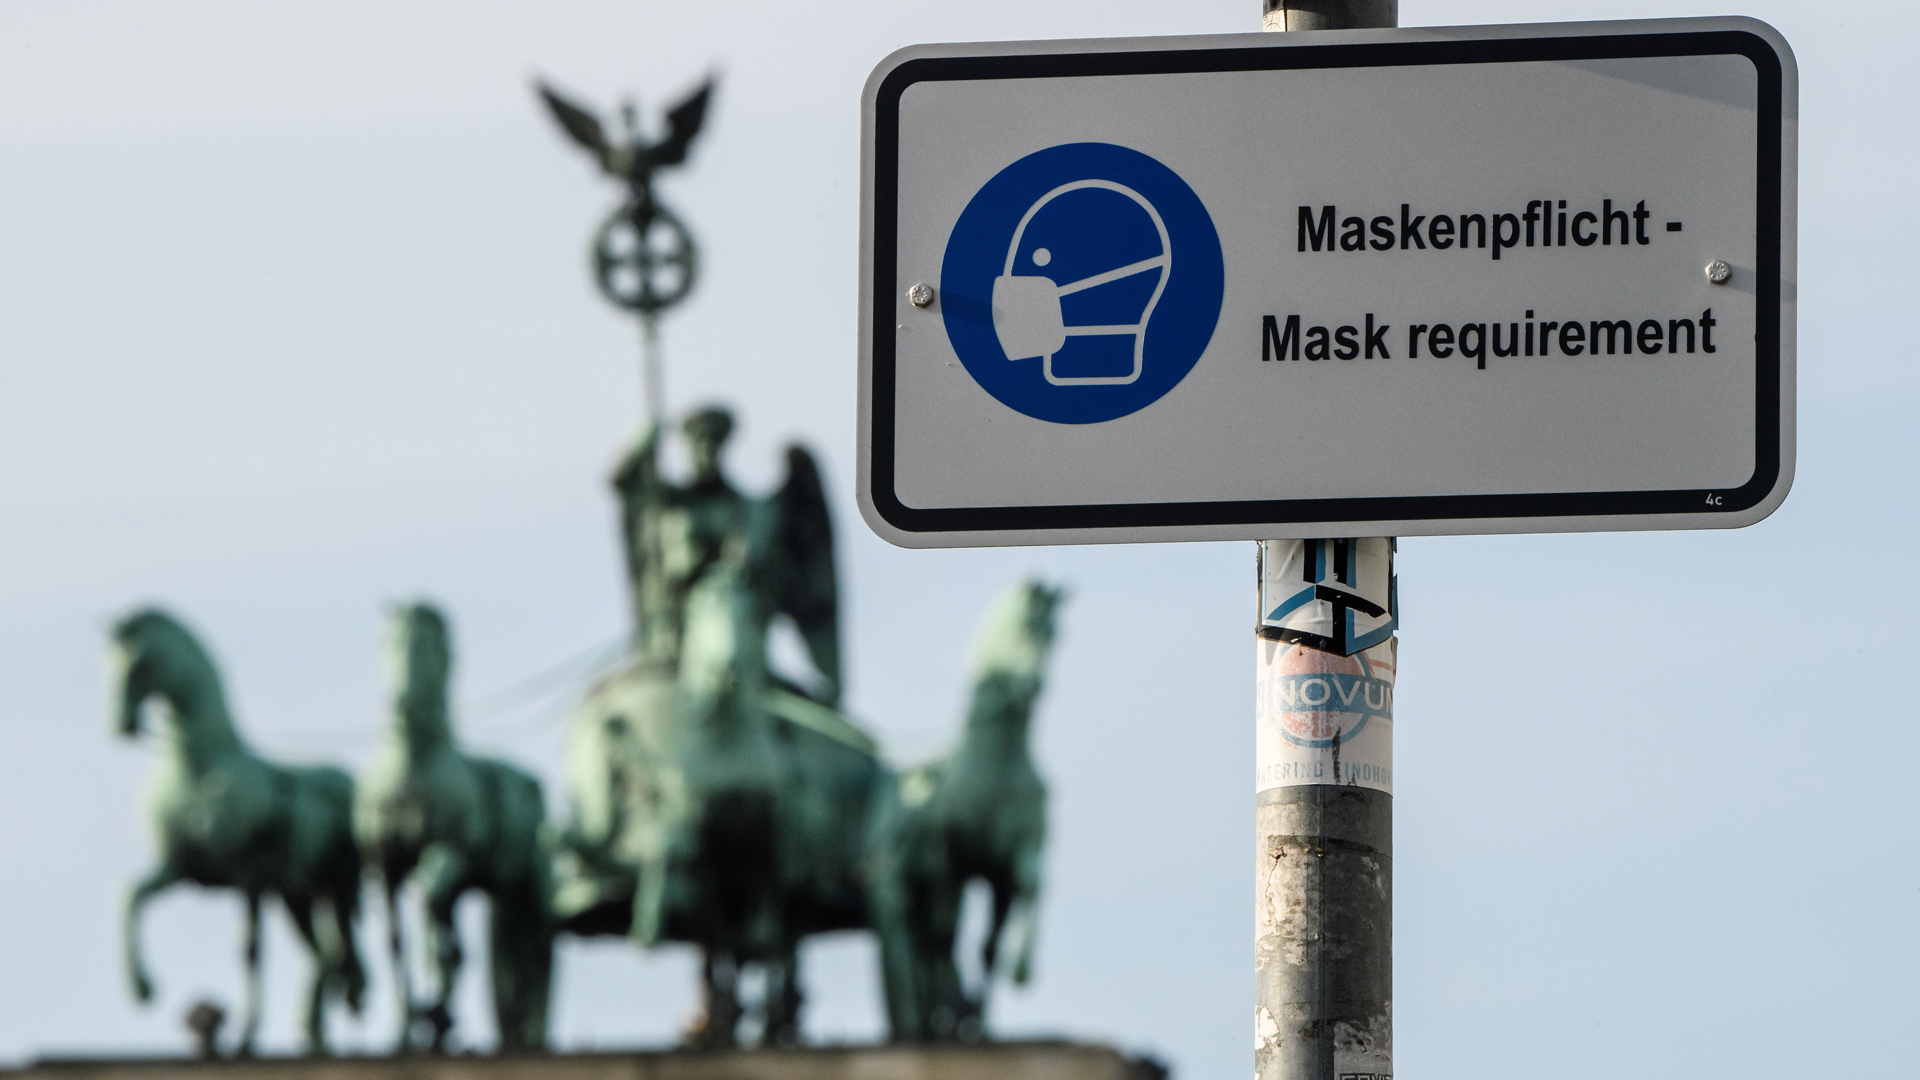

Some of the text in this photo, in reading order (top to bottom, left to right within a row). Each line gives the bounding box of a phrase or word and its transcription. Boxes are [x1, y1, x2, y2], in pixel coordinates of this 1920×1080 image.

[1297, 198, 1650, 260] Maskenpflicht
[1261, 308, 1716, 369] Mask requirement
[1705, 493, 1723, 506] 4c
